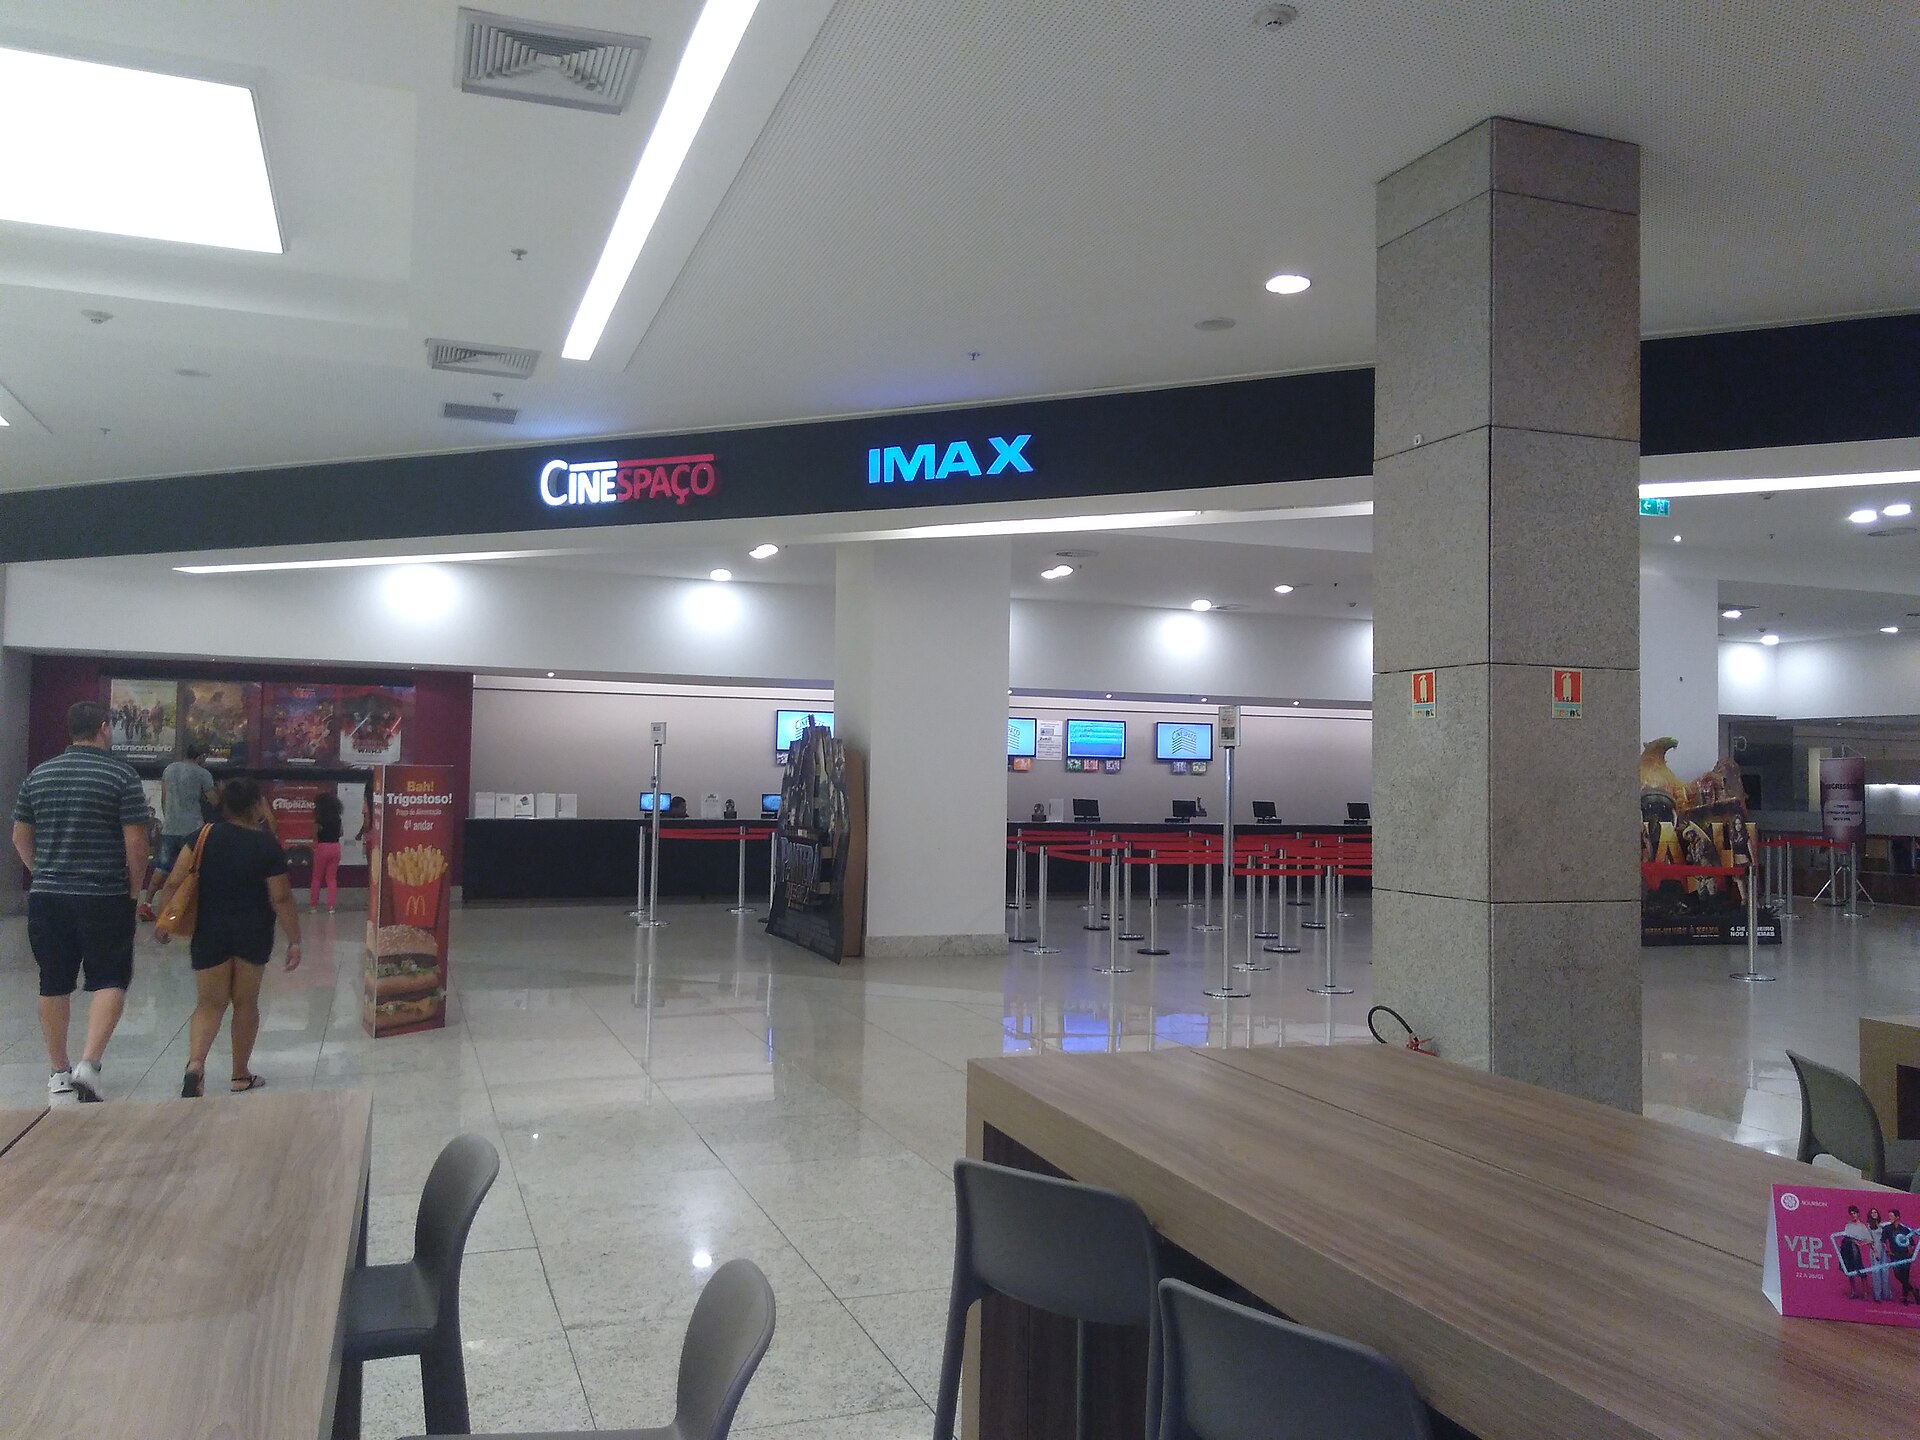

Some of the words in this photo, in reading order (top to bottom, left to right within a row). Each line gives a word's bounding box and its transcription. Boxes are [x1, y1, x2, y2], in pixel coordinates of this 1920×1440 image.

[868, 434, 1034, 484] IMAX
[540, 456, 718, 506] CINESPAÇO
[407, 781, 434, 792] Bah!
[387, 793, 453, 807] Trigostoso!
[413, 820, 434, 831] andar
[1784, 1234, 1823, 1253] VIP
[1797, 1250, 1833, 1270] LET
